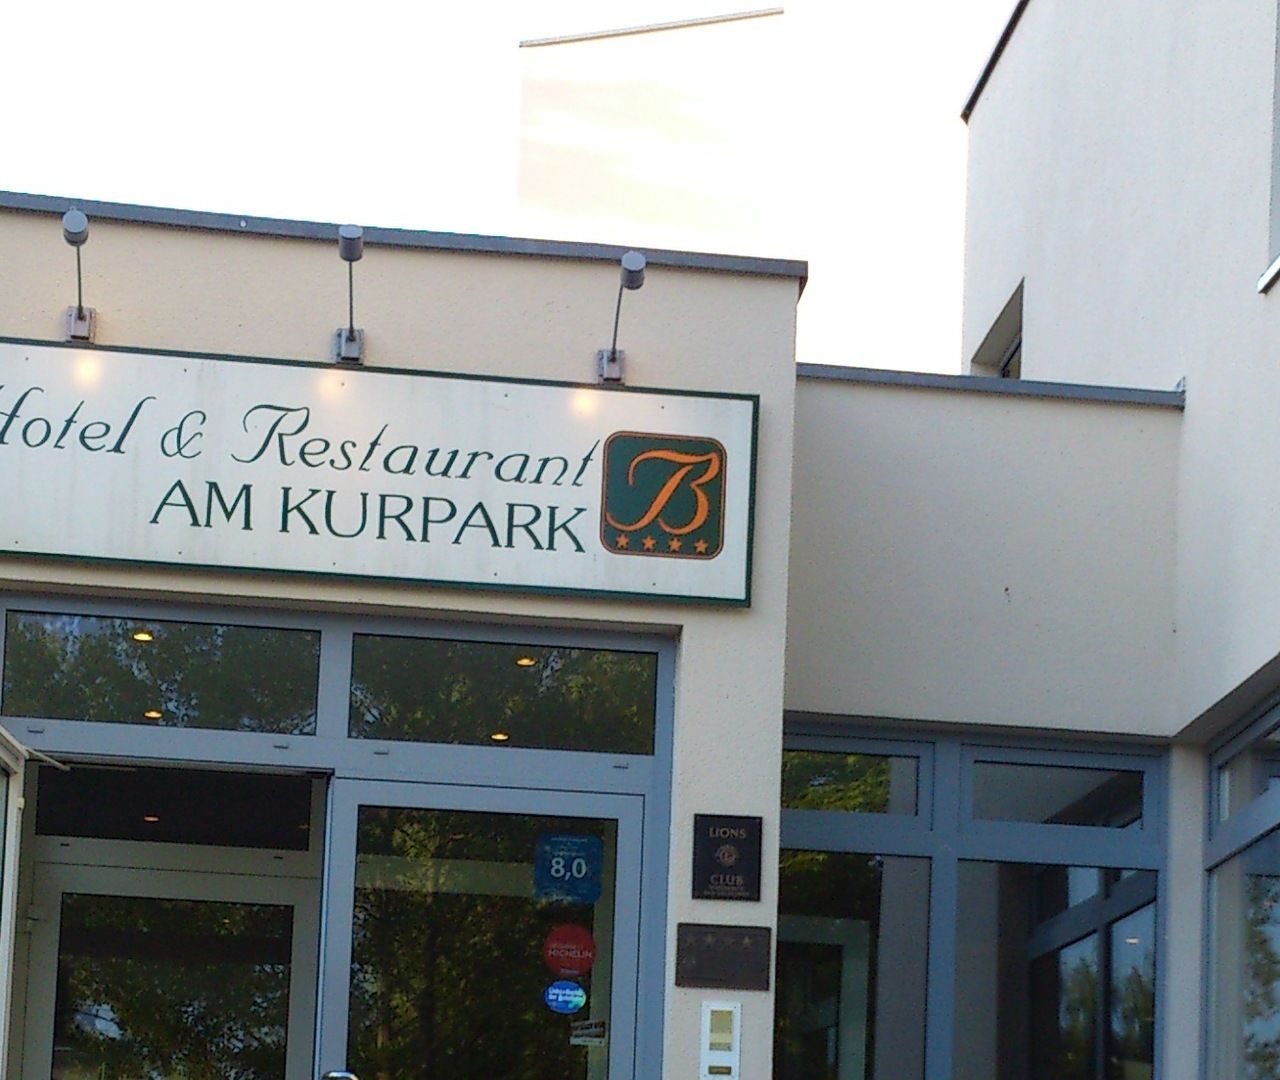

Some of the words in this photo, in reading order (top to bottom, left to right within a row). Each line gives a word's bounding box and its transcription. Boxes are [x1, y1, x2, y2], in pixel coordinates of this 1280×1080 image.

[160, 410, 207, 459] &
[230, 403, 600, 487] Restaurant
[149, 479, 254, 531] AM
[278, 486, 588, 553] KURPARK
[708, 827, 747, 839] LIONS
[550, 856, 587, 881] 8,0
[710, 874, 744, 886] CLUB
